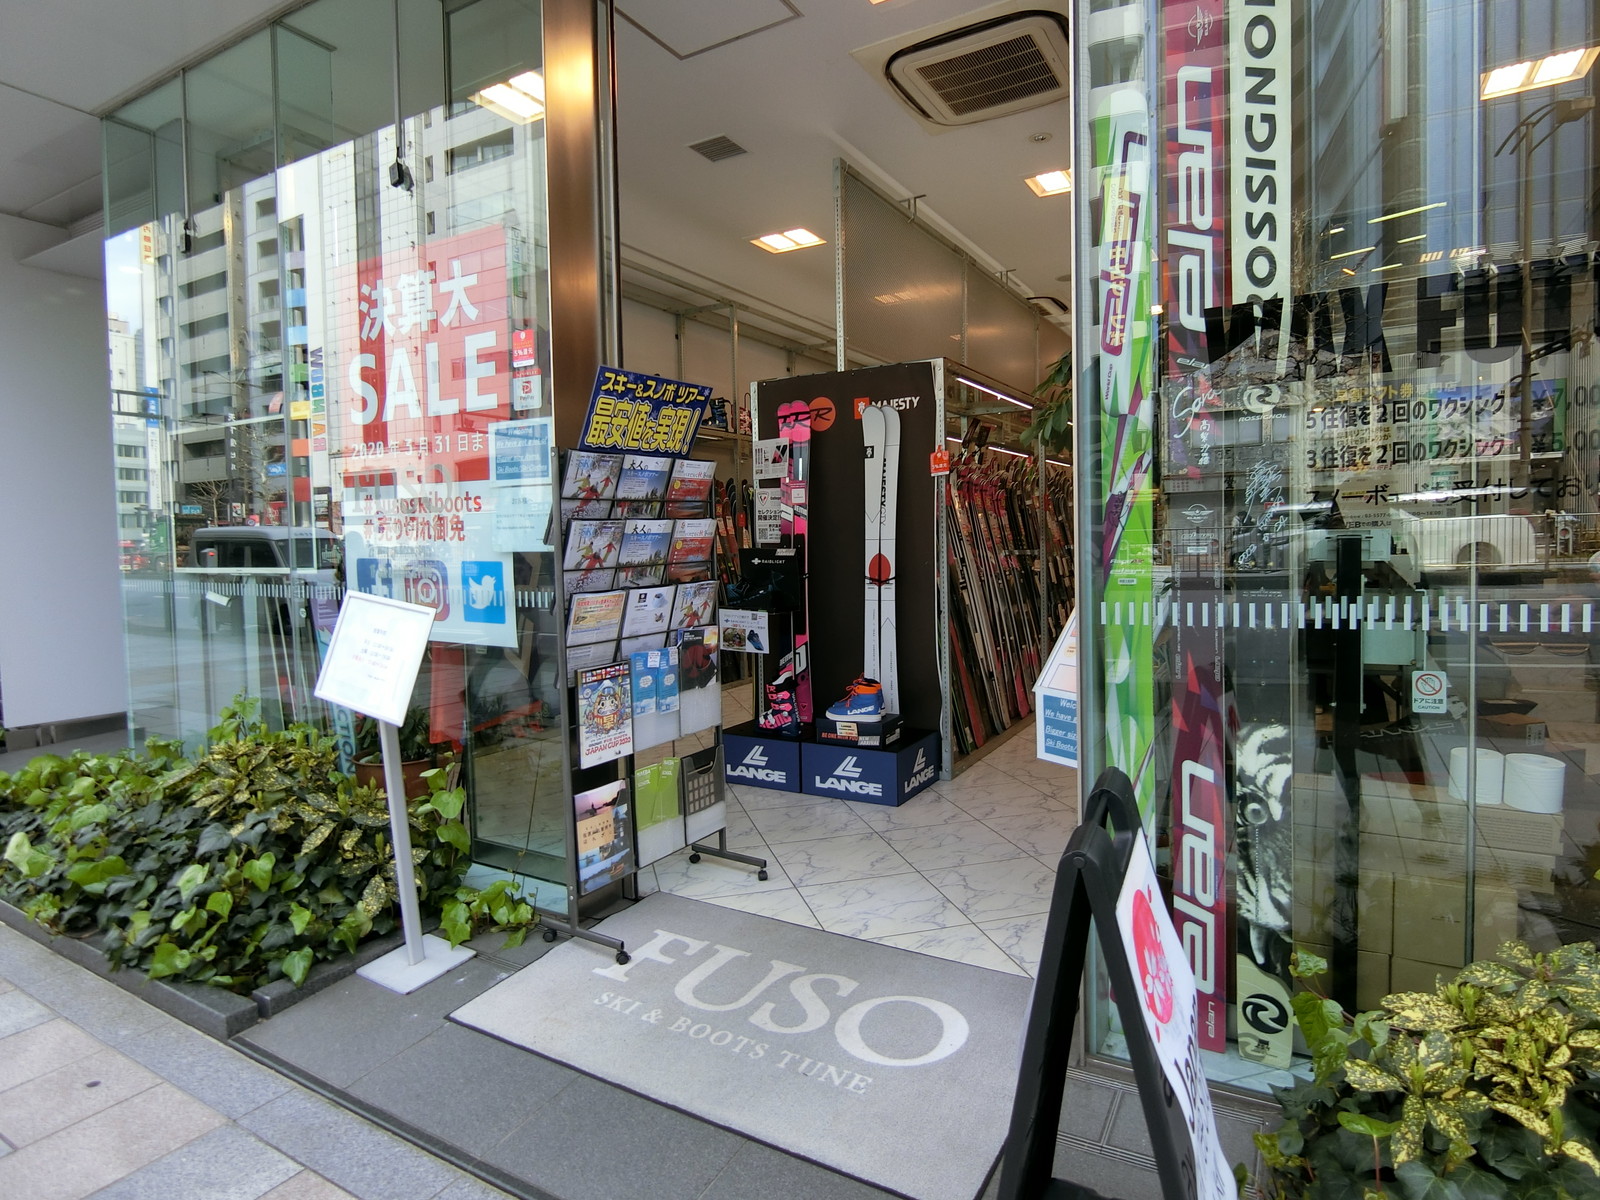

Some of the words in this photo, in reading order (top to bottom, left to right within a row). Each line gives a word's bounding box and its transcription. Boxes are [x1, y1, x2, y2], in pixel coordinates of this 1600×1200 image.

[1244, 0, 1278, 303] OSSIGNO
[1168, 65, 1213, 332] elan
[359, 259, 479, 341] 決算大
[351, 330, 498, 426] SALE
[872, 396, 920, 411] MAJESTY
[1239, 412, 1287, 423] ROSSIGNOL
[847, 704, 875, 715] LANGE
[1413, 697, 1444, 705] ドアに注意
[1045, 708, 1056, 717] We
[1057, 711, 1072, 721] have
[1045, 724, 1066, 736] Bigger
[585, 742, 608, 755] JAPAN
[608, 740, 619, 749] CUP
[1046, 738, 1056, 746] Ski
[727, 764, 787, 784] LANGE
[904, 764, 935, 793] LANGE
[815, 775, 883, 797] LANGE
[1174, 759, 1215, 995] elan
[592, 929, 970, 1067] FUSO
[1206, 1001, 1216, 1038] elan
[593, 991, 643, 1016] SKI
[642, 1008, 664, 1025] &
[668, 1016, 770, 1060] BOOTS
[779, 1050, 874, 1096] TUNE
